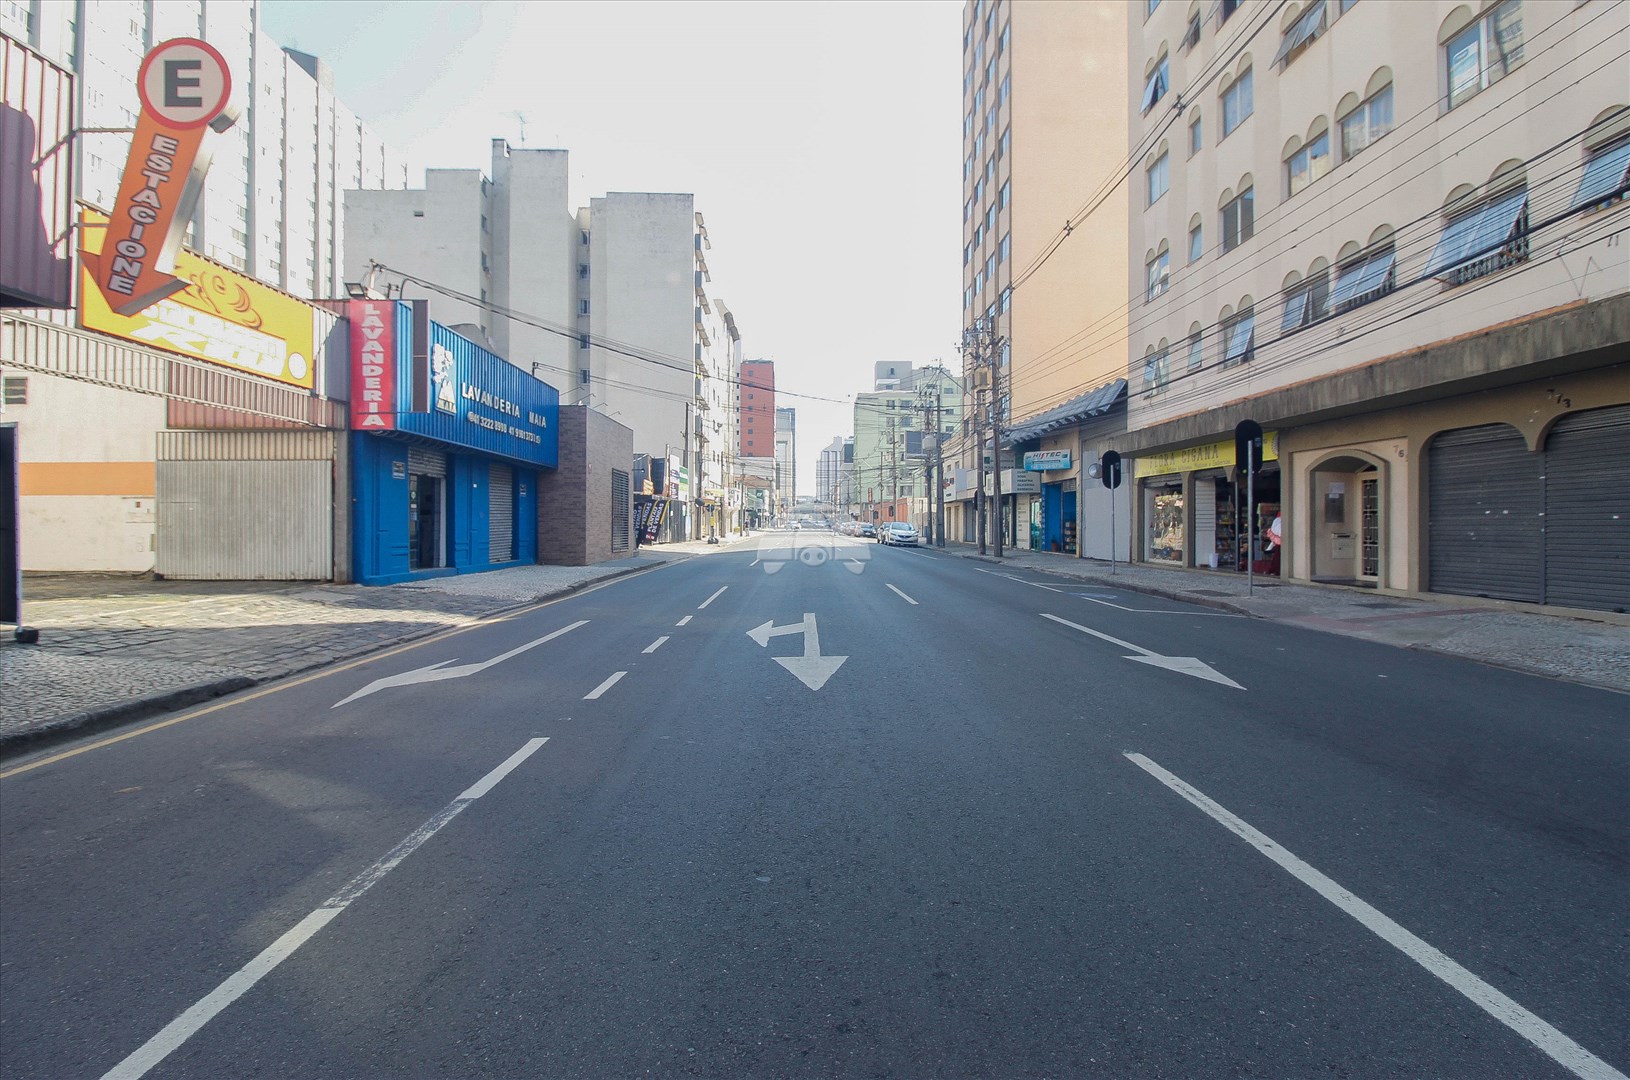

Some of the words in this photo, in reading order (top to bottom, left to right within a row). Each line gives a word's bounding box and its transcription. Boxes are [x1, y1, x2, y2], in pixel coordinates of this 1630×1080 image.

[164, 60, 202, 107] E
[107, 133, 179, 296] ESTACIONE
[361, 303, 385, 426] LAVANDERIA
[461, 382, 520, 418] LAVANDERIA
[529, 411, 546, 428] MAIA
[1181, 444, 1219, 463] CIGANA
